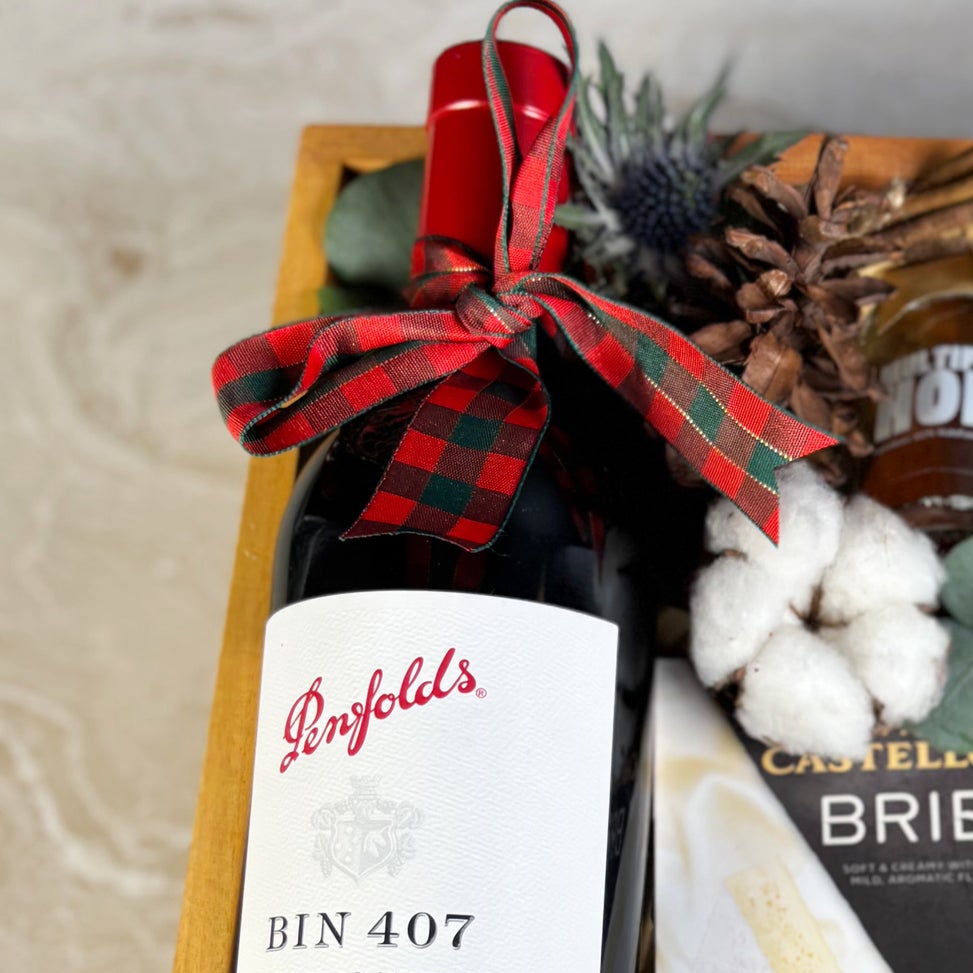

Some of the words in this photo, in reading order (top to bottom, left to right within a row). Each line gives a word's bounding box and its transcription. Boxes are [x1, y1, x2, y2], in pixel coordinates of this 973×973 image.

[279, 647, 477, 773] Penfolds
[888, 872, 955, 884] AROMATIC
[892, 861, 944, 872] CREAMY
[266, 911, 352, 952] BIN
[367, 911, 475, 950] 407
